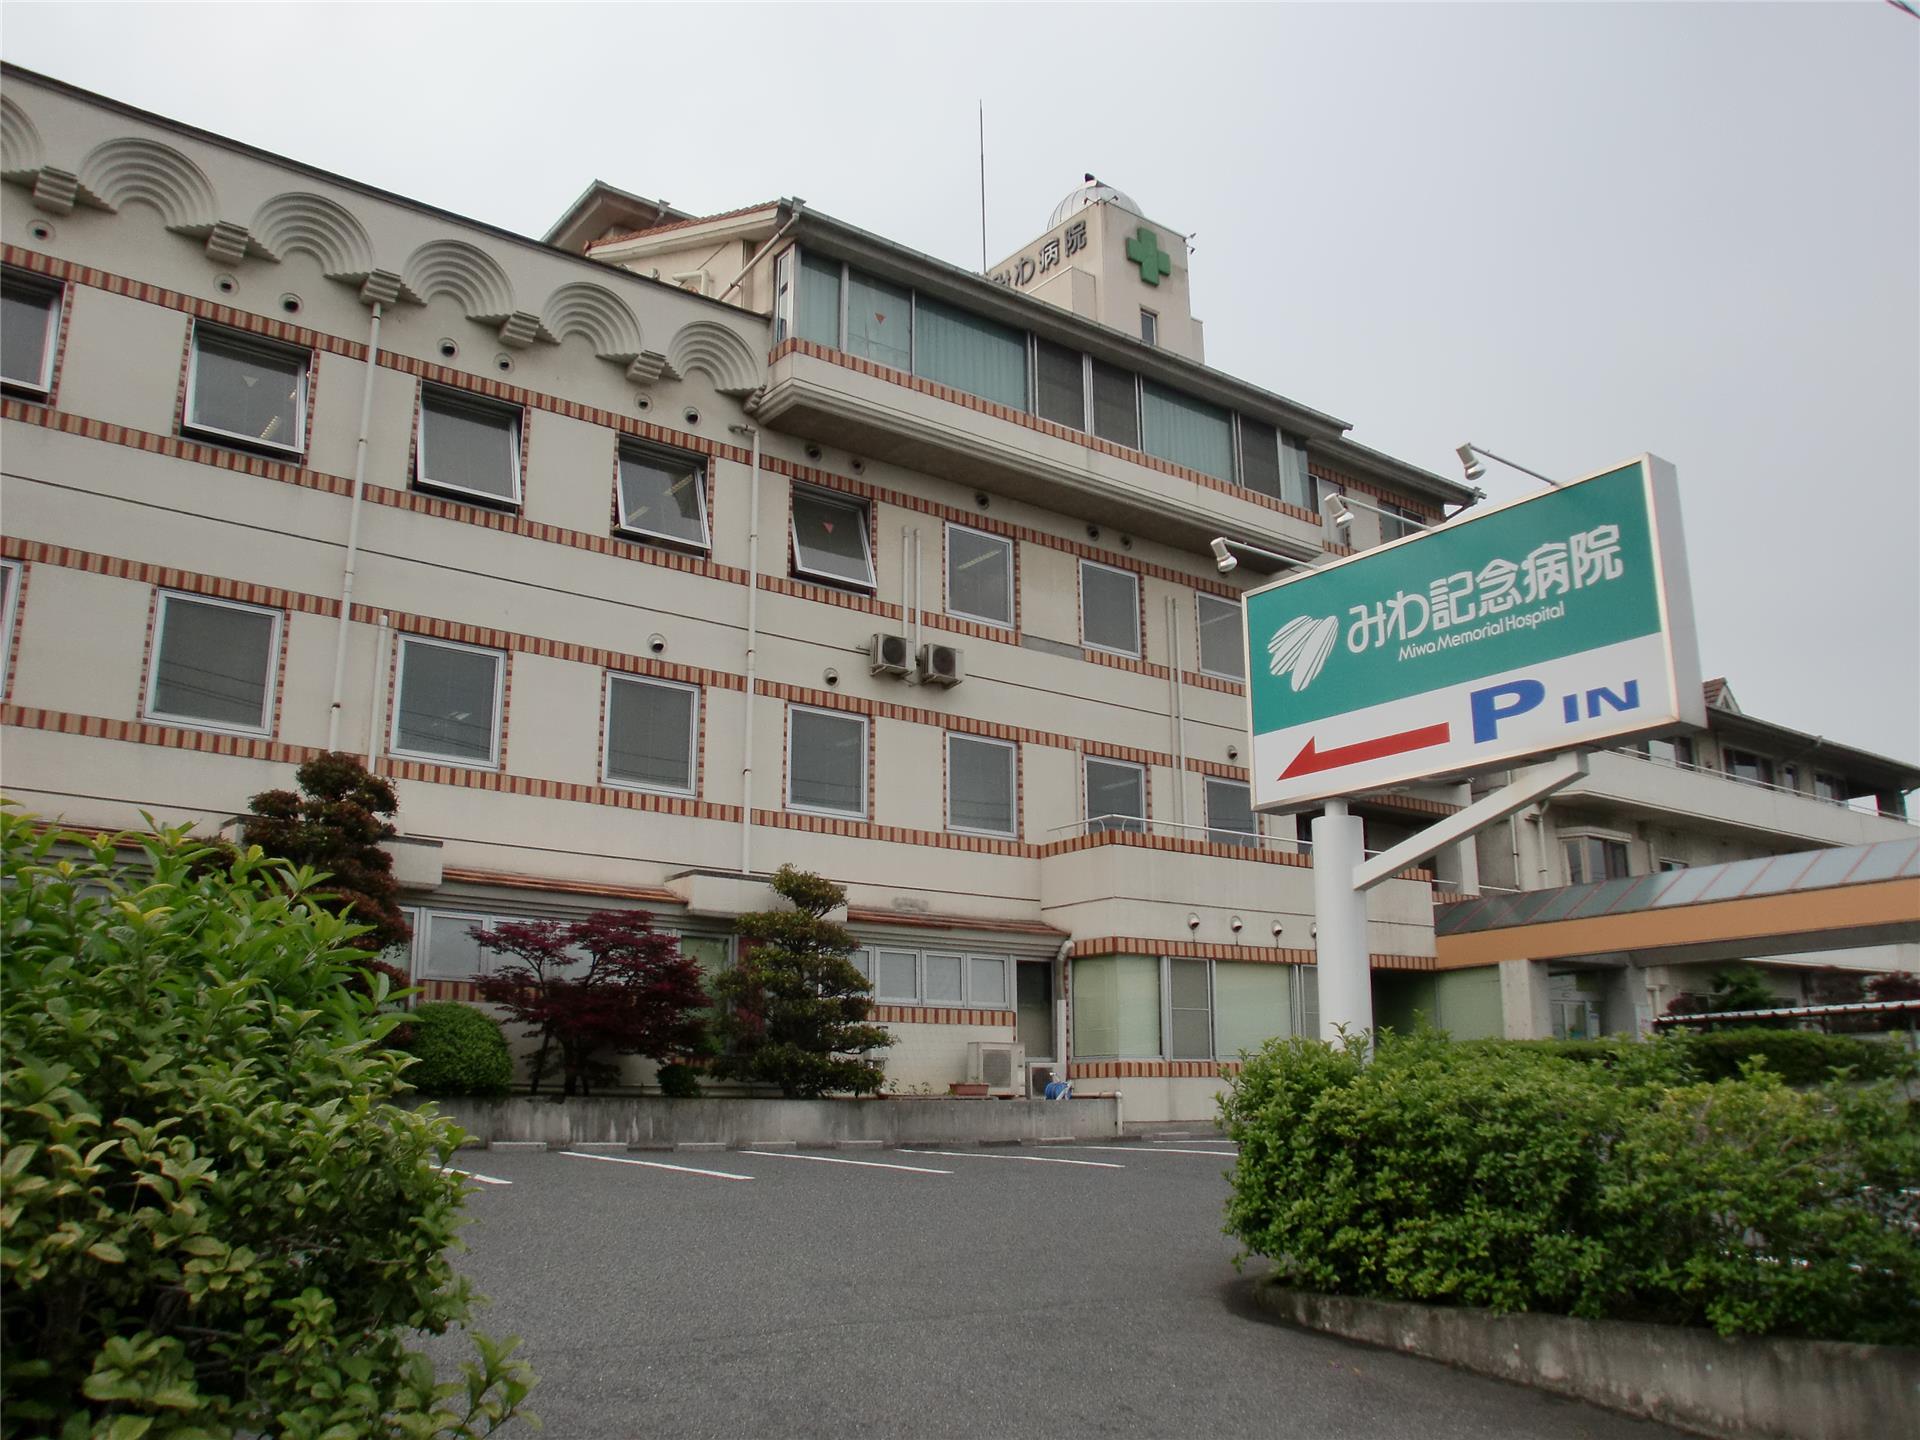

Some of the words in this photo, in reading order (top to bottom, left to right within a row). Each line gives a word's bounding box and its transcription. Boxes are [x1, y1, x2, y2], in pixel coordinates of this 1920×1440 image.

[1348, 524, 1623, 653] みわ記念病院
[1399, 642, 1437, 662] Miwa
[1437, 618, 1504, 653] Memorial
[1505, 602, 1565, 630] Hospital
[1470, 679, 1545, 744] P
[1563, 680, 1639, 723] IN
